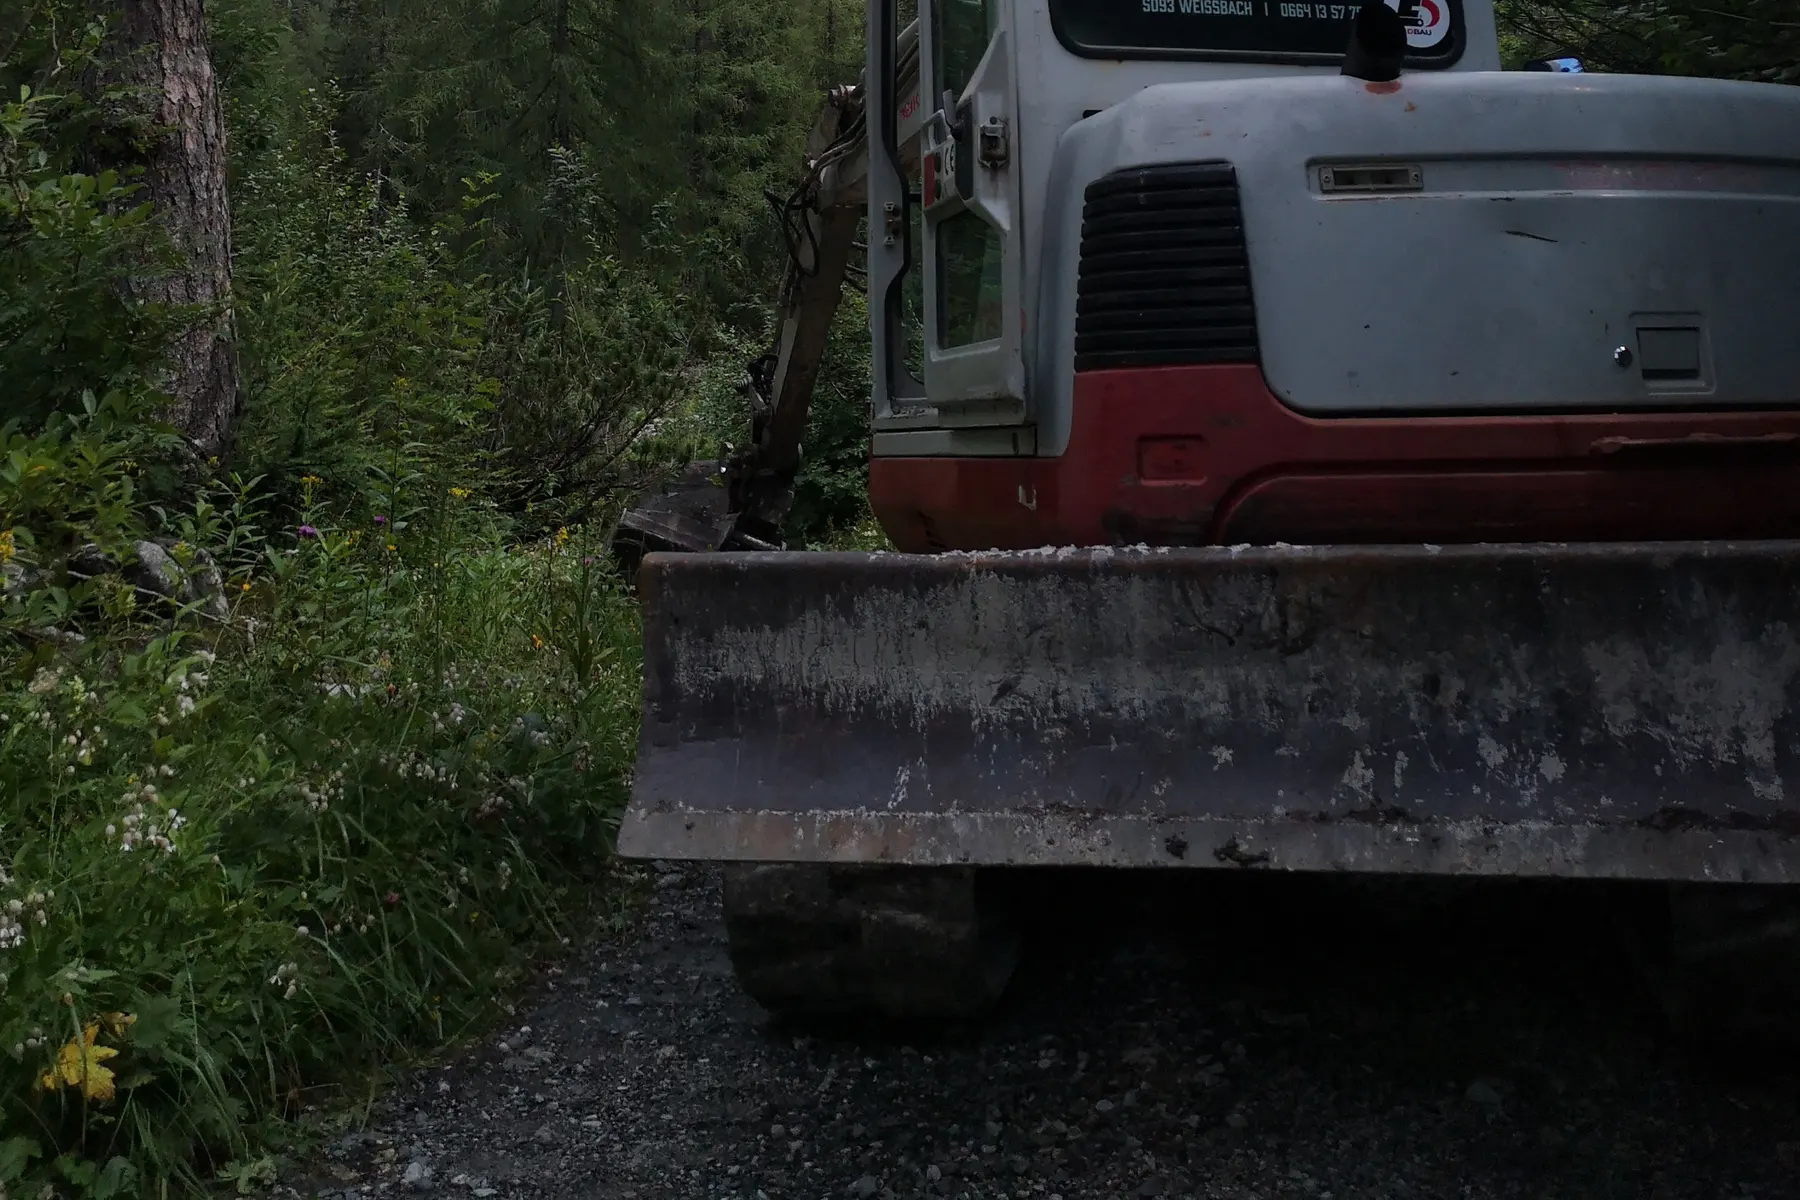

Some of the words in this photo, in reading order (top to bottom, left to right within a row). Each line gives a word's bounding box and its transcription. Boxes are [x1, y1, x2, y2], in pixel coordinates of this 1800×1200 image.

[1280, 2, 1311, 19] 0664
[1315, 4, 1327, 19] 13
[1330, 4, 1345, 20] 57
